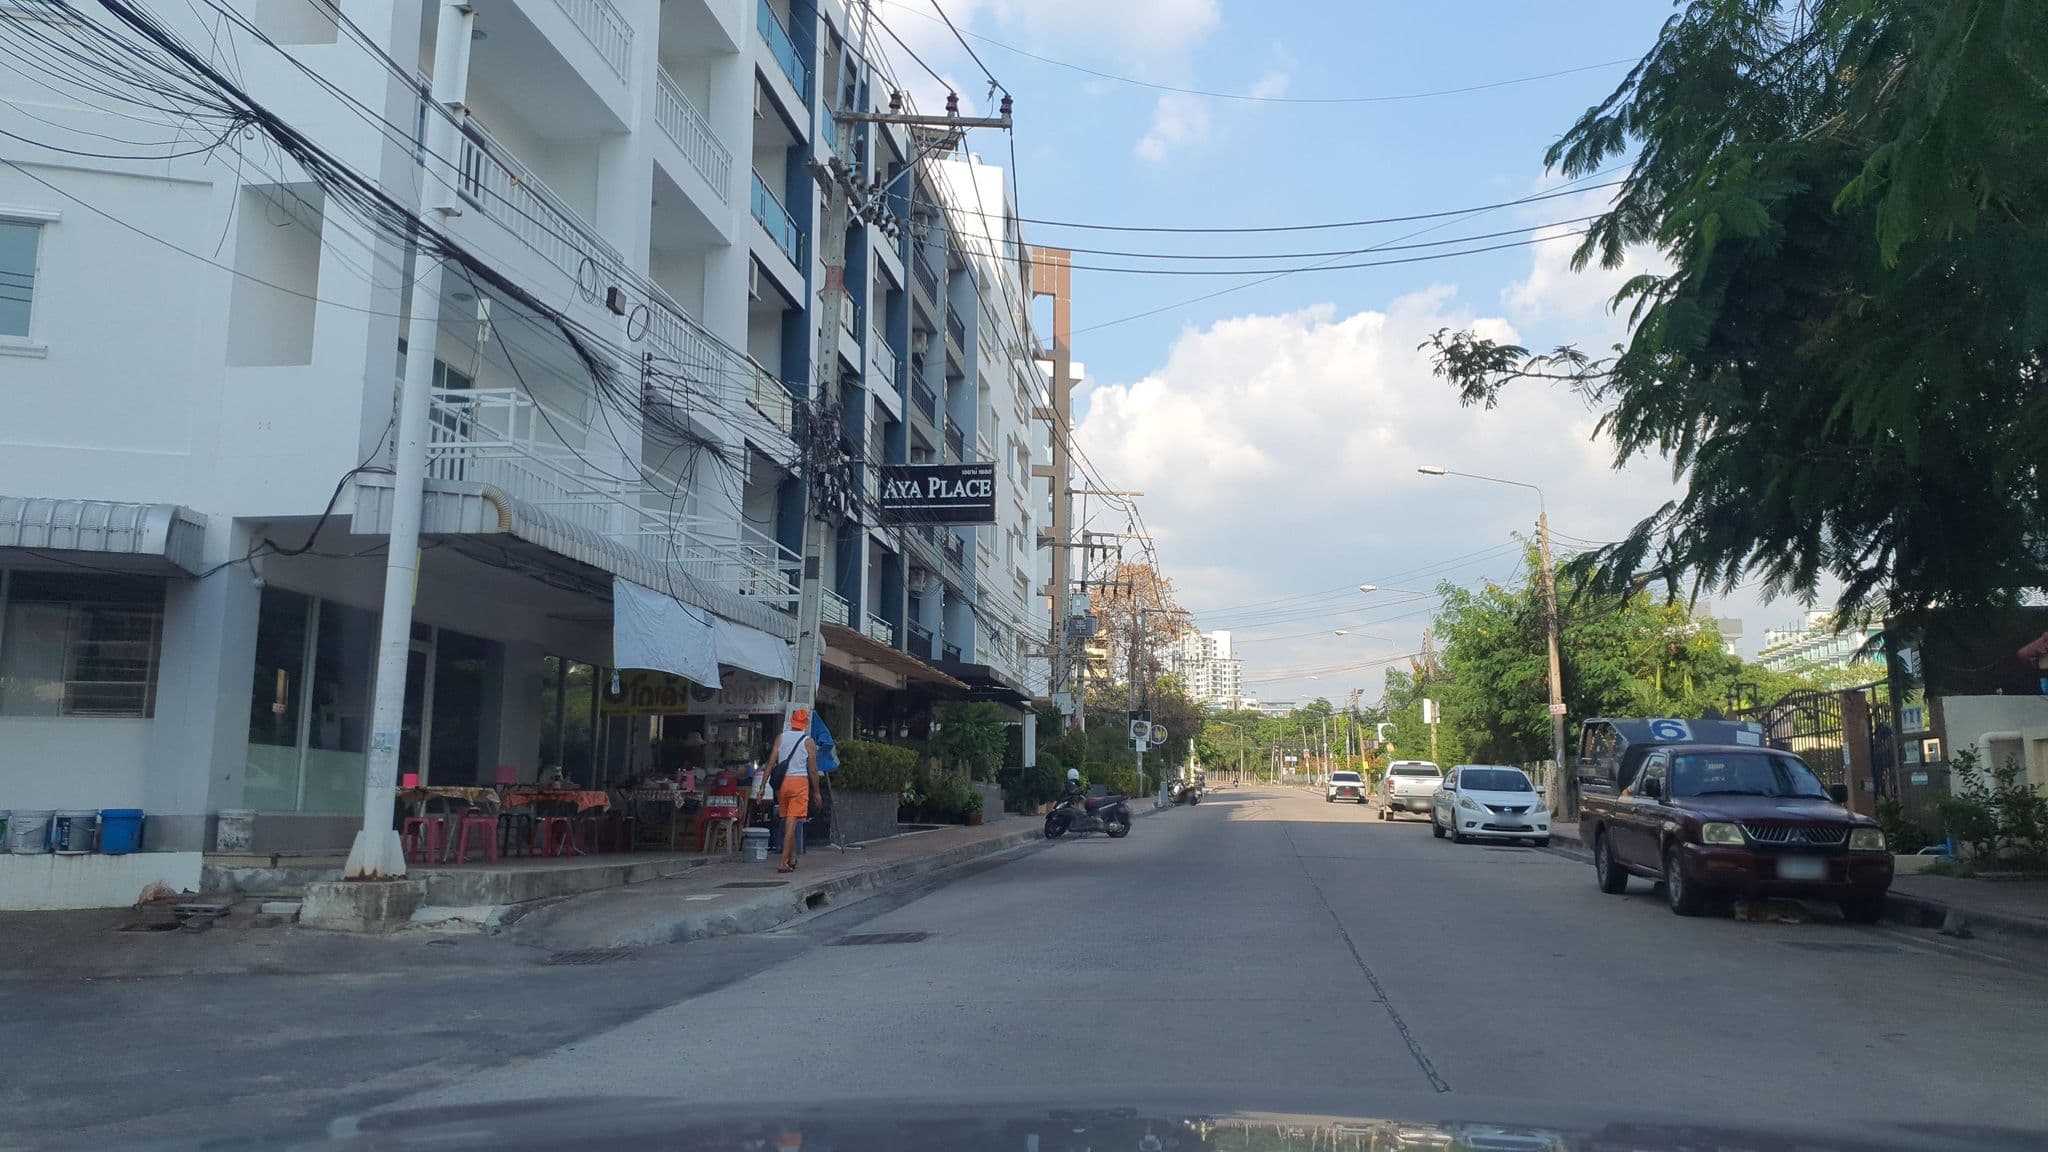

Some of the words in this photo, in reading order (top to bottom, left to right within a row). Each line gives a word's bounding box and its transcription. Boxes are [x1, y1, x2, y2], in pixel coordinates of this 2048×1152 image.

[883, 478, 923, 499] AYA
[928, 477, 992, 498] PLACE
[1651, 719, 1687, 740] 6
